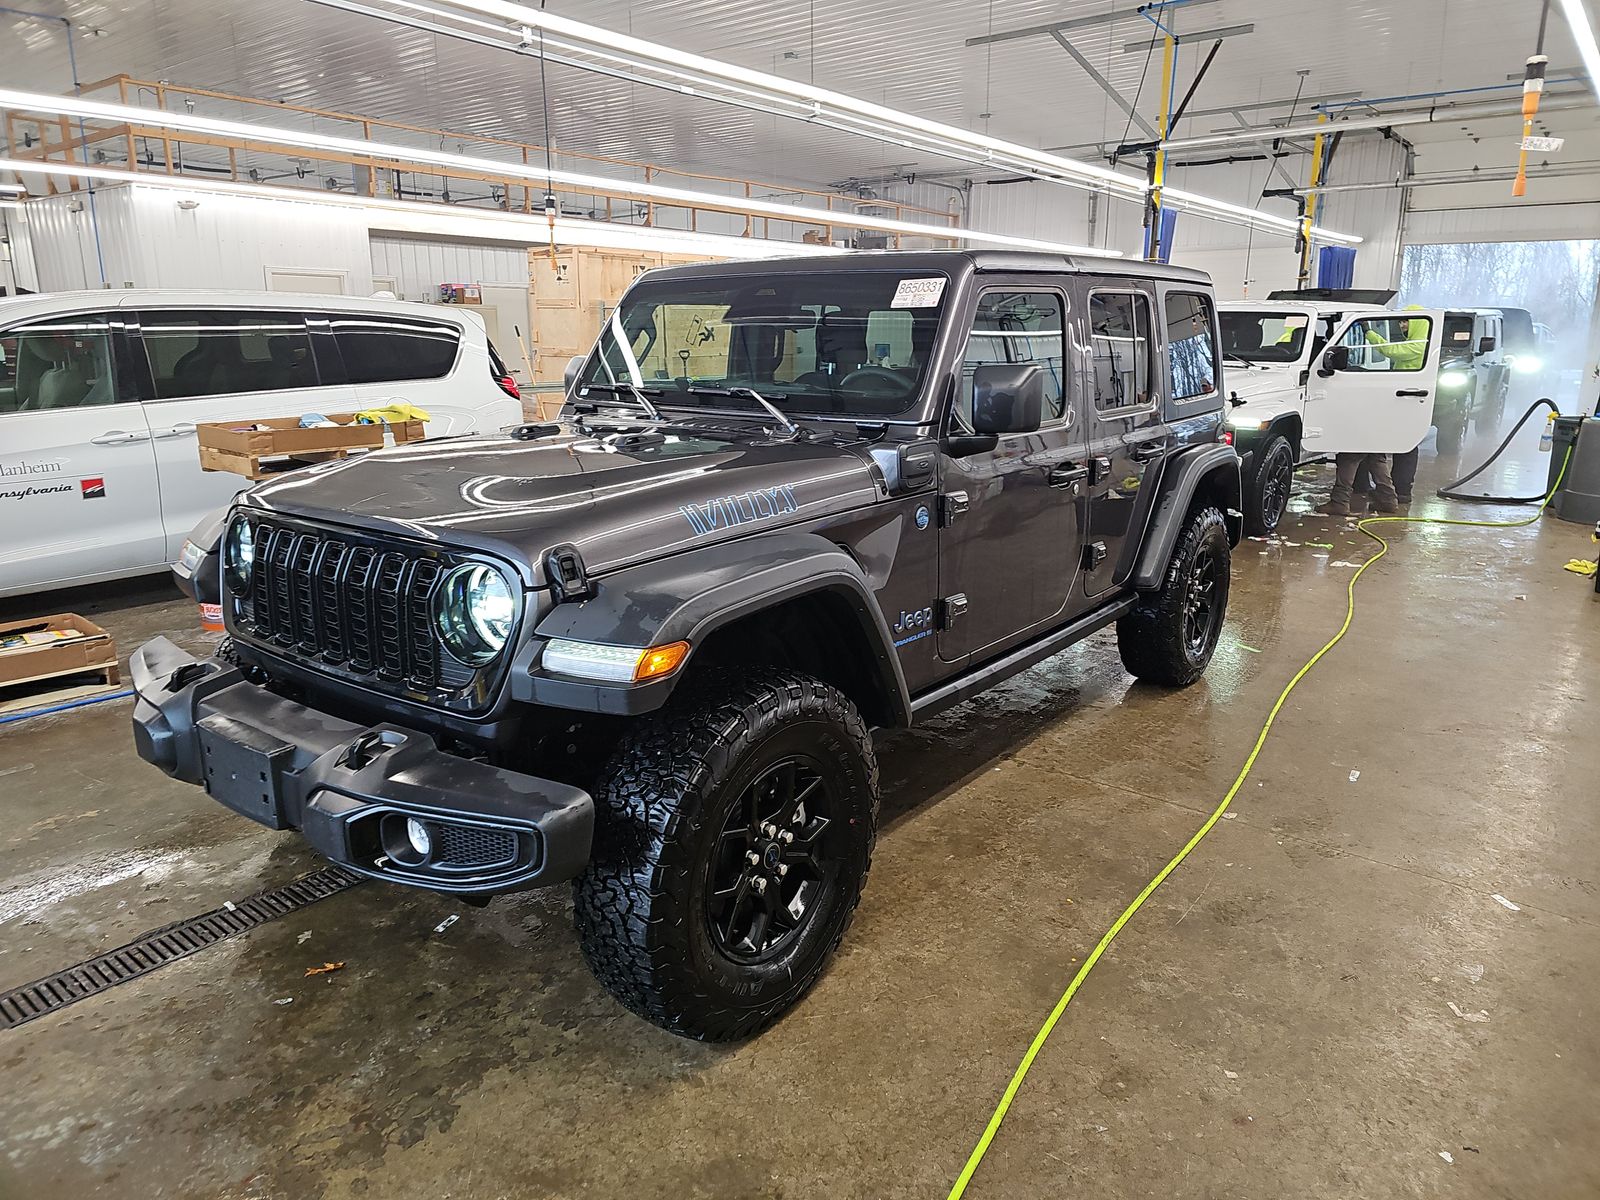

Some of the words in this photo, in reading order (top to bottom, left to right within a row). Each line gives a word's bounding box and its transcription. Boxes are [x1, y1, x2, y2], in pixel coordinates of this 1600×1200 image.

[898, 281, 944, 295] 8650331
[679, 484, 798, 535] WILLYS
[893, 607, 933, 633] Jeep
